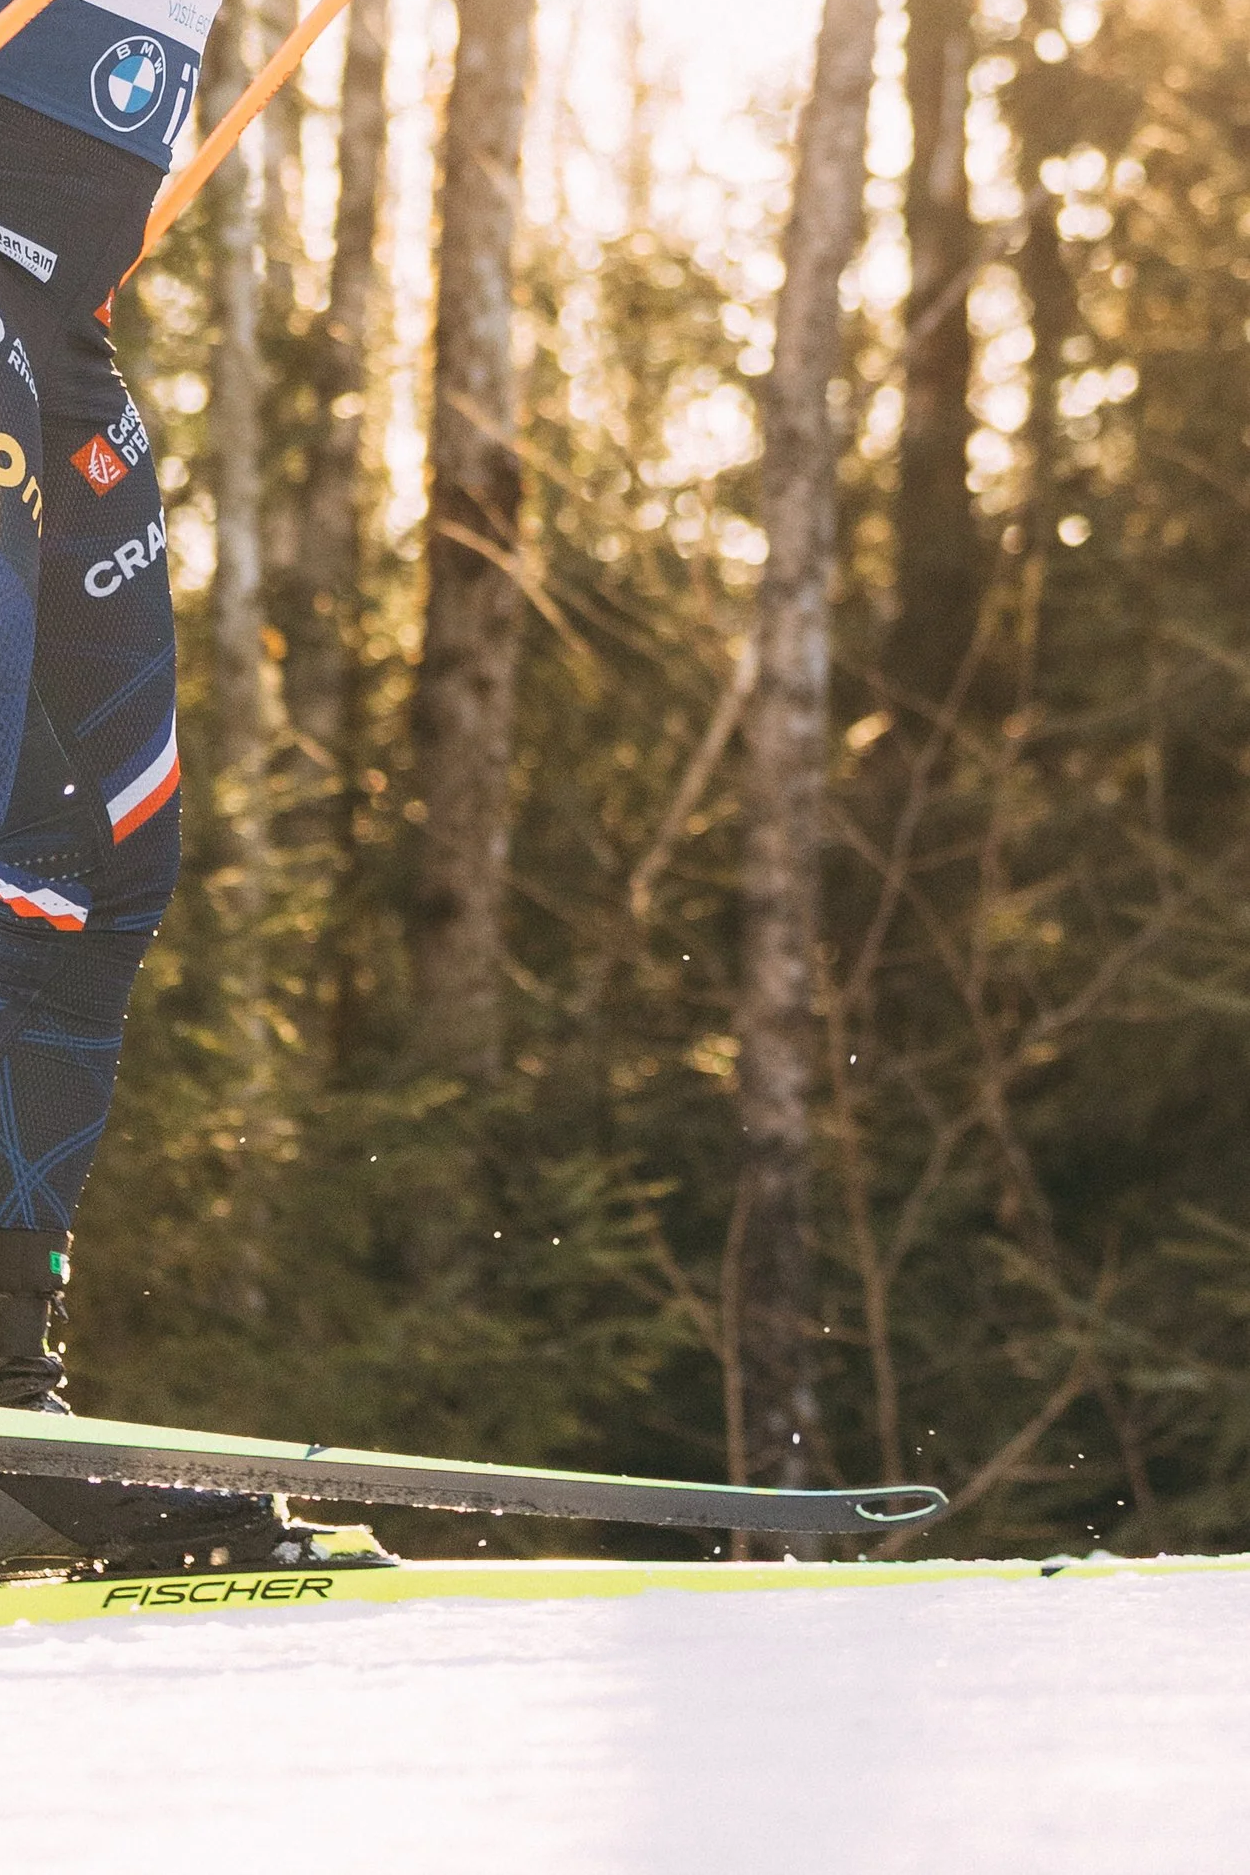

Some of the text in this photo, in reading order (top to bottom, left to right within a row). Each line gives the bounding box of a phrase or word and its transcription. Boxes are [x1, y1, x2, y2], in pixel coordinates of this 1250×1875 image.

[116, 41, 164, 75] BMW
[83, 506, 167, 598] CRA
[101, 1576, 334, 1609] FISCHER
